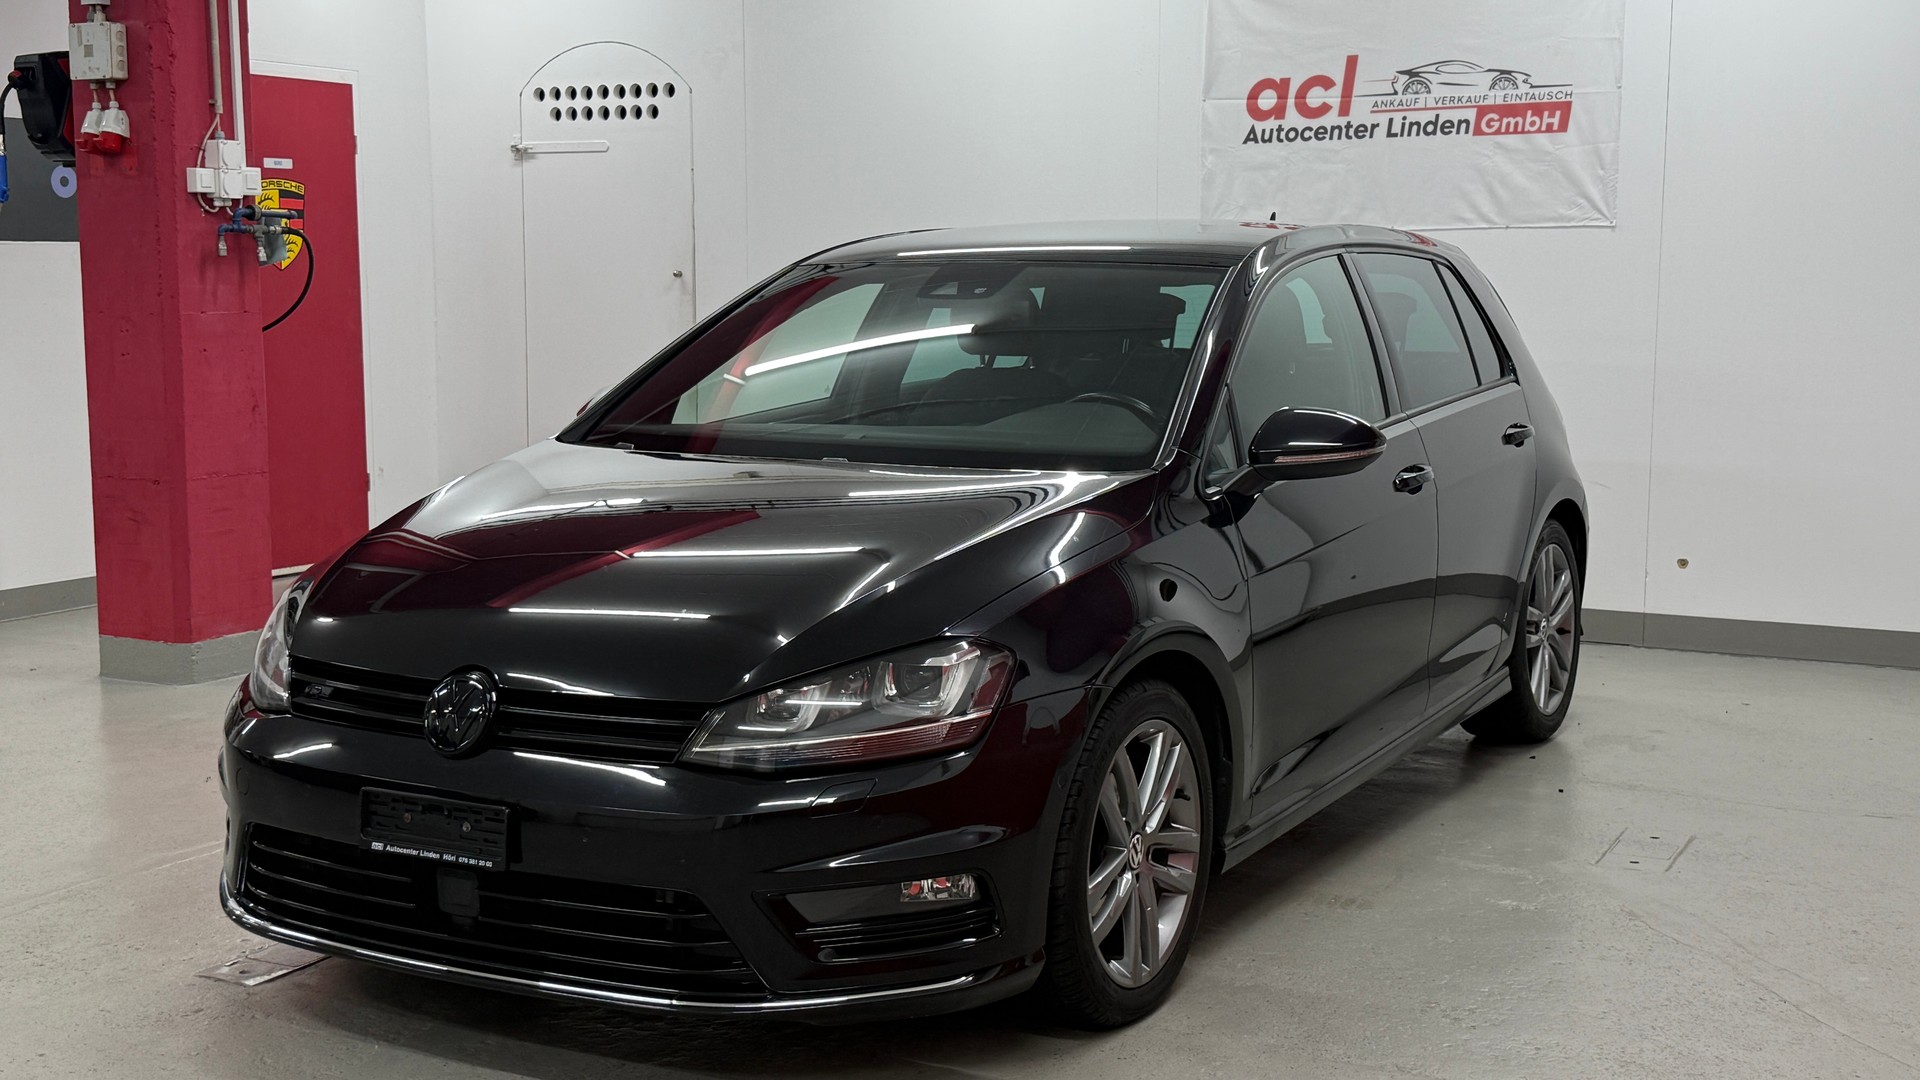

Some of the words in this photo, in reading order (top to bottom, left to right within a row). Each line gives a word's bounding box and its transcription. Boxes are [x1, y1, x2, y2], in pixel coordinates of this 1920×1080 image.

[1245, 54, 1359, 122] acl
[1372, 97, 1420, 109] ANKAUF
[1434, 94, 1489, 106] VERKAUF
[1502, 90, 1573, 103] EINTAUSCH
[1242, 119, 1380, 145] Autocenter
[1386, 114, 1471, 138] Linden
[1480, 110, 1561, 133] GmbH
[261, 181, 303, 193] ORSCHE
[386, 844, 419, 856] Autocenter
[420, 850, 440, 859] Linden
